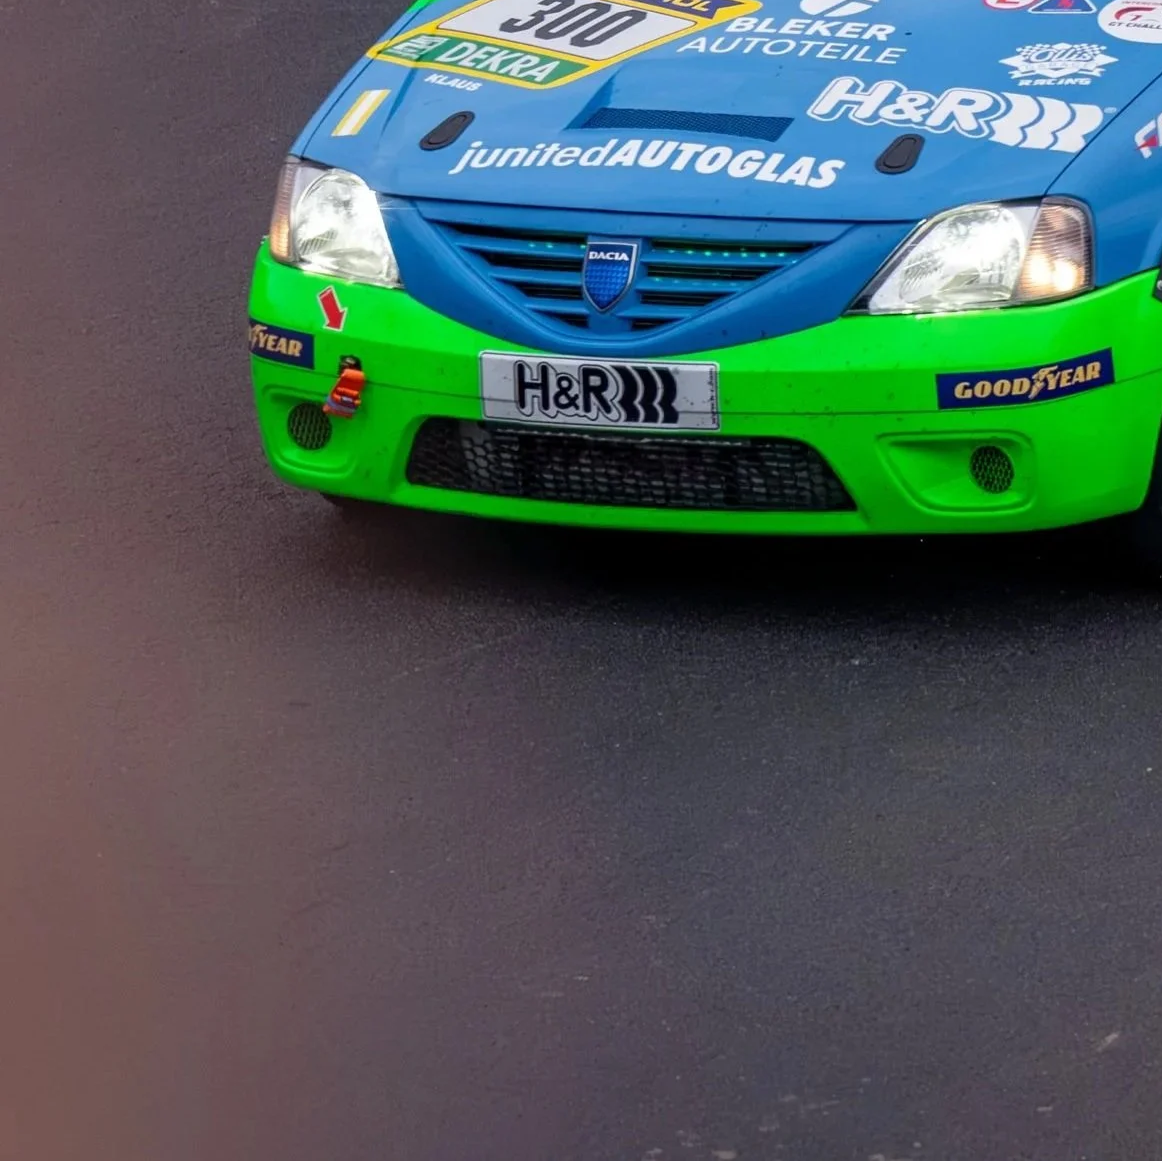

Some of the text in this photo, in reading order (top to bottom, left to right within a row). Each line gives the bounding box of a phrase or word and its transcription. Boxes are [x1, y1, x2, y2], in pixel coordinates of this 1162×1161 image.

[723, 16, 897, 41] BLEKER
[434, 41, 562, 83] DEKRA
[676, 38, 908, 65] AUTOTEILE
[424, 73, 483, 92] KLAUS
[1018, 77, 1091, 86] RACING
[448, 139, 846, 190] junitedAUTOGLAS
[588, 250, 630, 262] DACIA
[953, 361, 1101, 400] GOODYEAR
